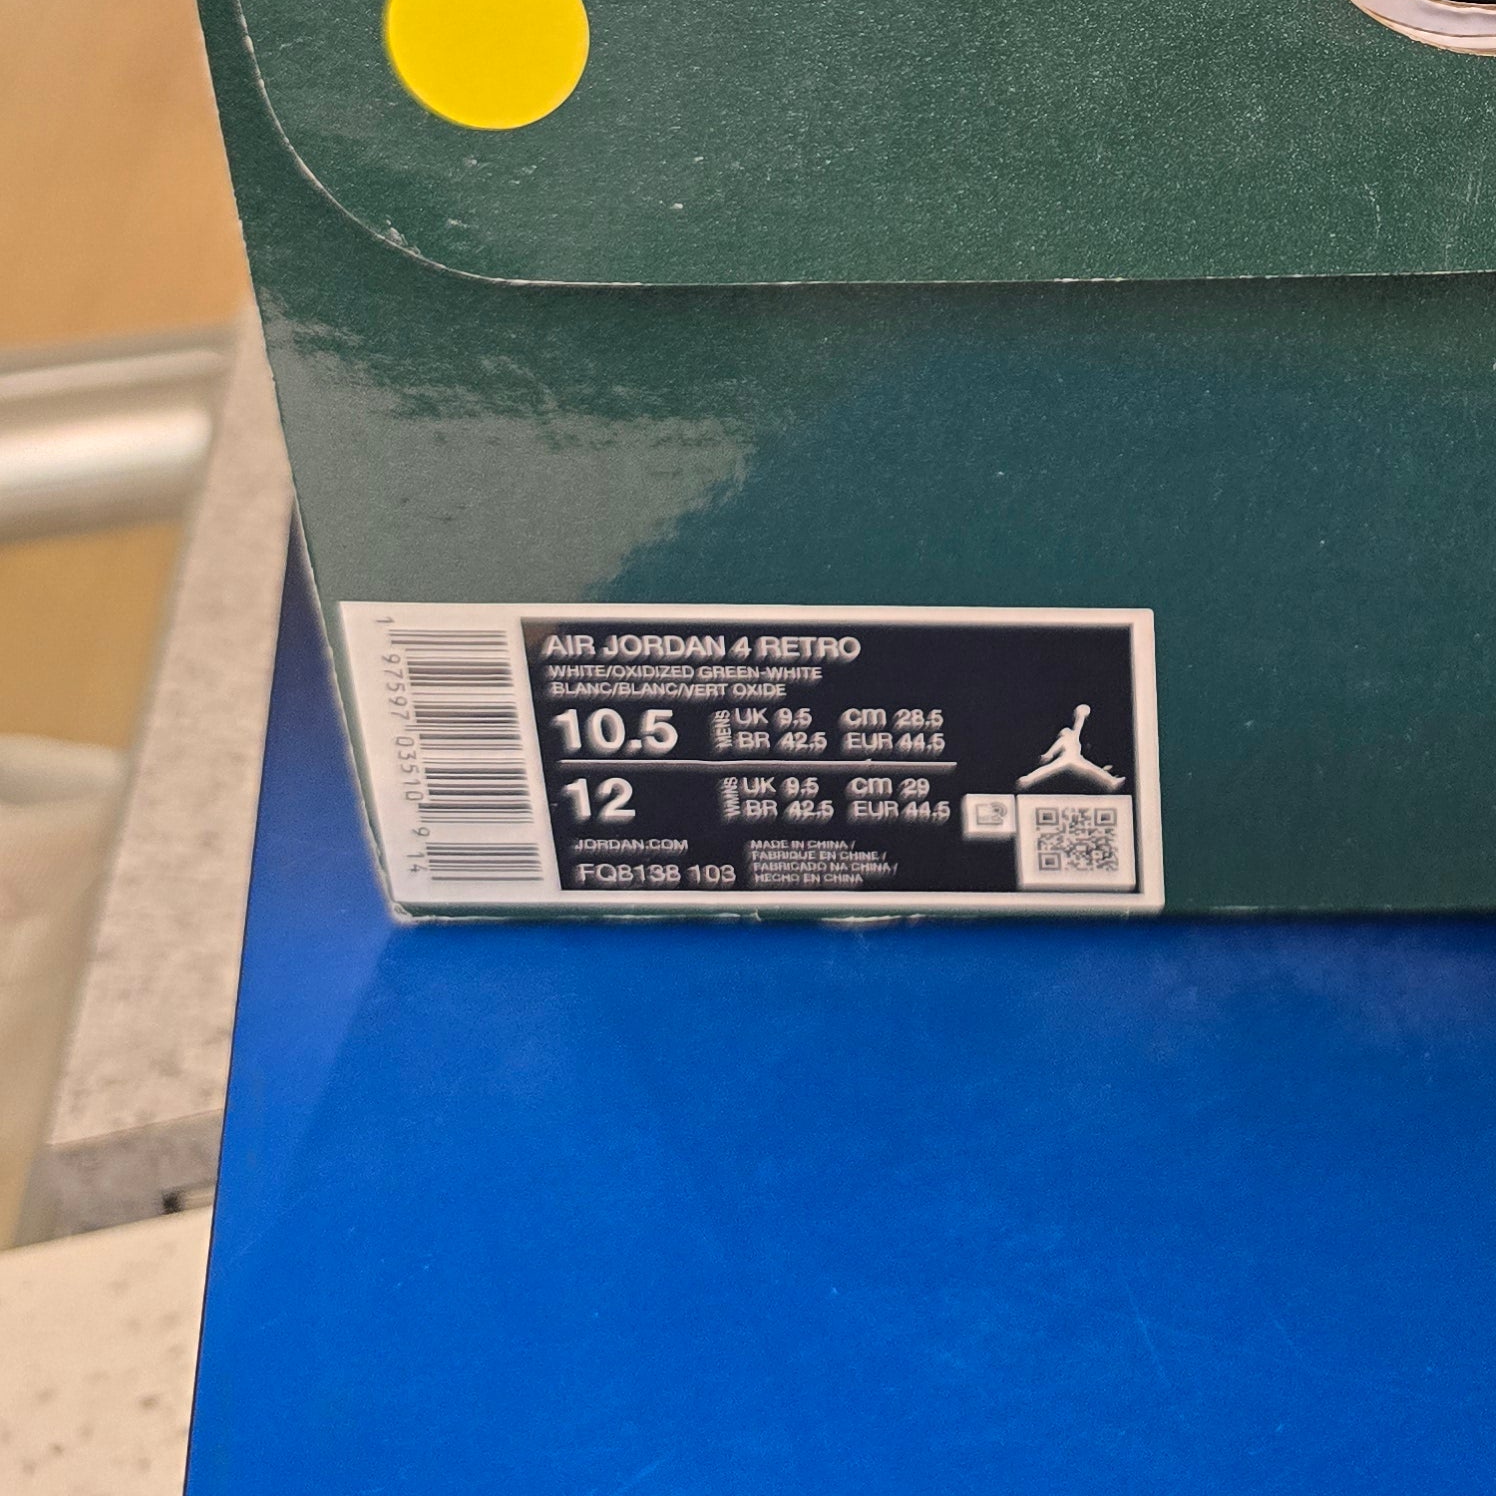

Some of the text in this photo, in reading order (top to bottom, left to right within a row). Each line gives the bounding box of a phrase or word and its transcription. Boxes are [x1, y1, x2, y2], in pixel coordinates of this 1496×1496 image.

[547, 634, 862, 660] AIR JORDAN 4 RETRO
[549, 664, 823, 680] WHITE/OXIDIZED GREEN-WHITE
[551, 681, 787, 697] BLANC/BLANC/VERT OXIDE
[734, 707, 813, 726] UK 9.5
[896, 708, 944, 727] 28.5
[553, 707, 679, 754] 10.5
[715, 709, 733, 748] MENS
[375, 615, 431, 874] 1 97597 03510 9 14
[738, 731, 828, 750] BR 42.5
[848, 732, 946, 752] EUR 44.5
[742, 776, 820, 796] UK 9.5
[900, 777, 931, 796] 29
[563, 776, 636, 821] 12
[746, 800, 834, 818] BR 42.5
[853, 800, 950, 820] EUR 44.5
[574, 838, 690, 852] JORDAN.COM
[749, 839, 790, 850] MADE
[791, 839, 805, 850] IN
[807, 839, 849, 850] CHINA
[819, 850, 837, 861] EN
[839, 851, 879, 861] CHINE
[576, 863, 737, 884] FQ8138 103
[753, 861, 828, 872] FABRICADO
[830, 861, 849, 872] NA
[754, 872, 864, 884] HECHO EN CHINA
